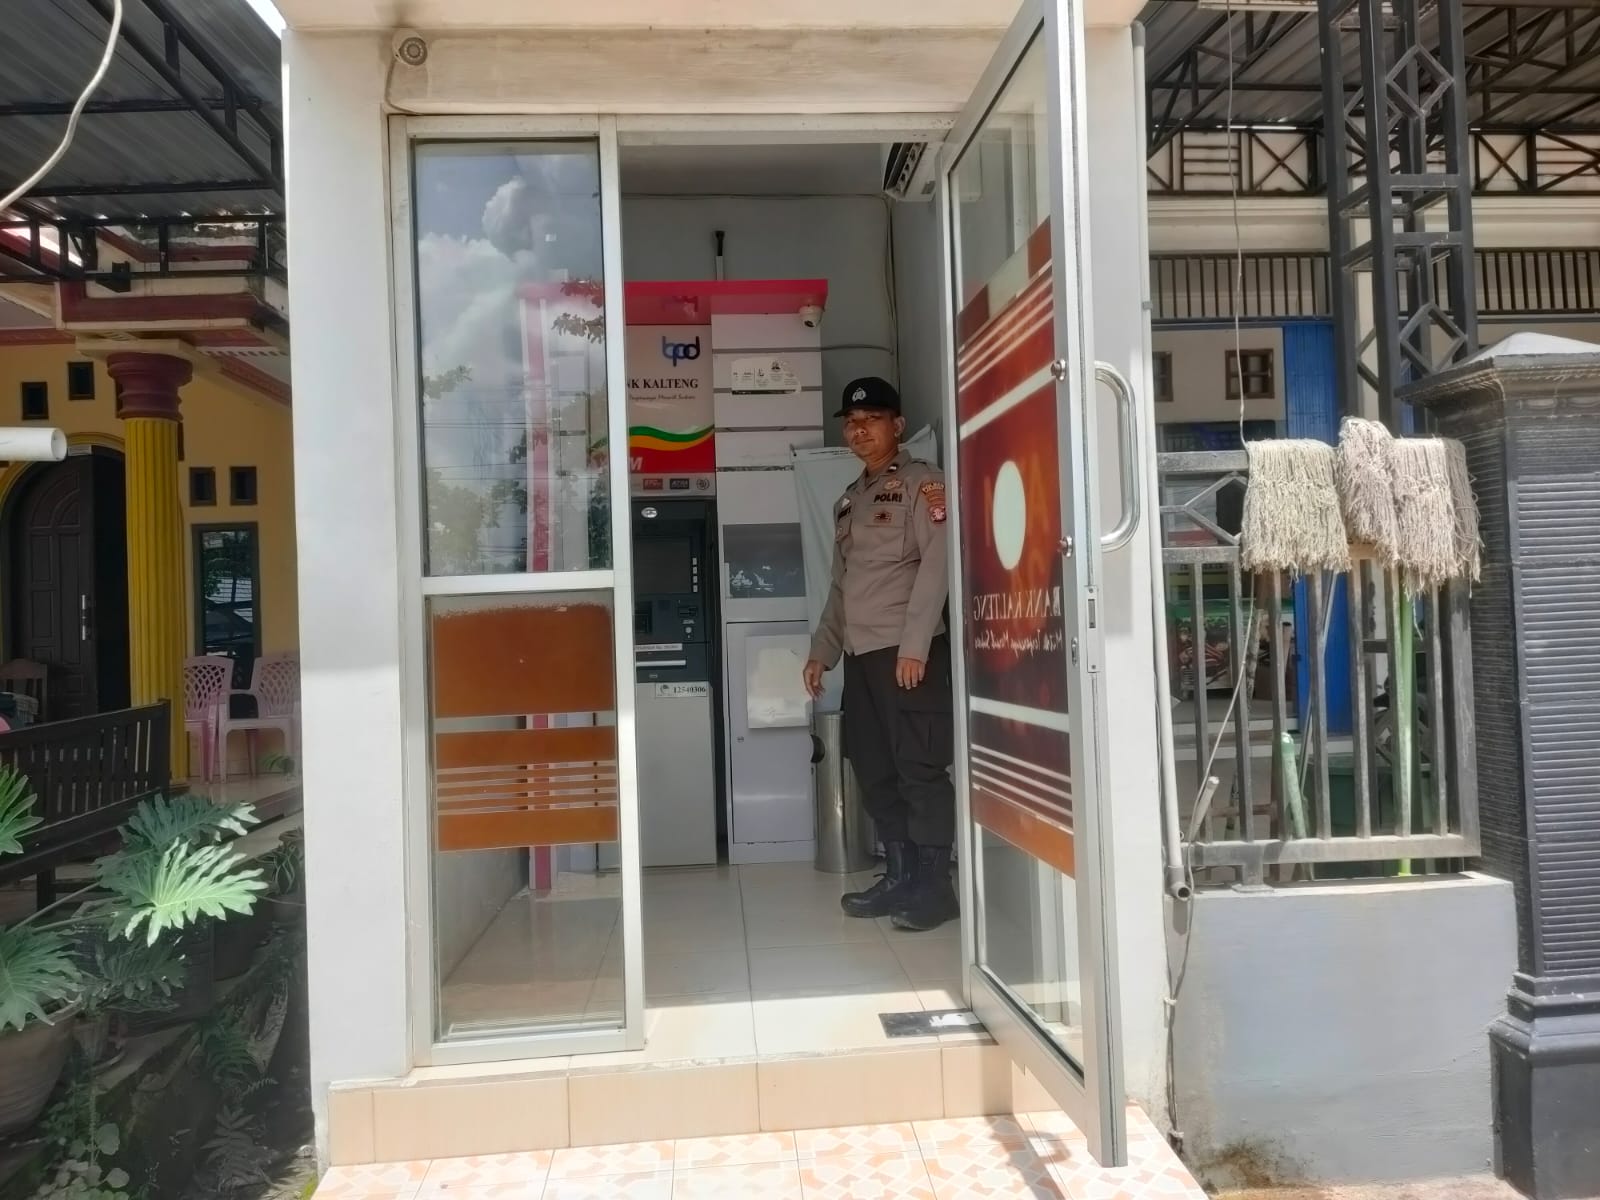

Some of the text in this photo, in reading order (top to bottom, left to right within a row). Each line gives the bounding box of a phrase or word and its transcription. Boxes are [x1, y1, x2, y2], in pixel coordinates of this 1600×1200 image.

[661, 335, 701, 368] bpd
[643, 378, 699, 389] KALTENG
[873, 493, 903, 503] POLRI
